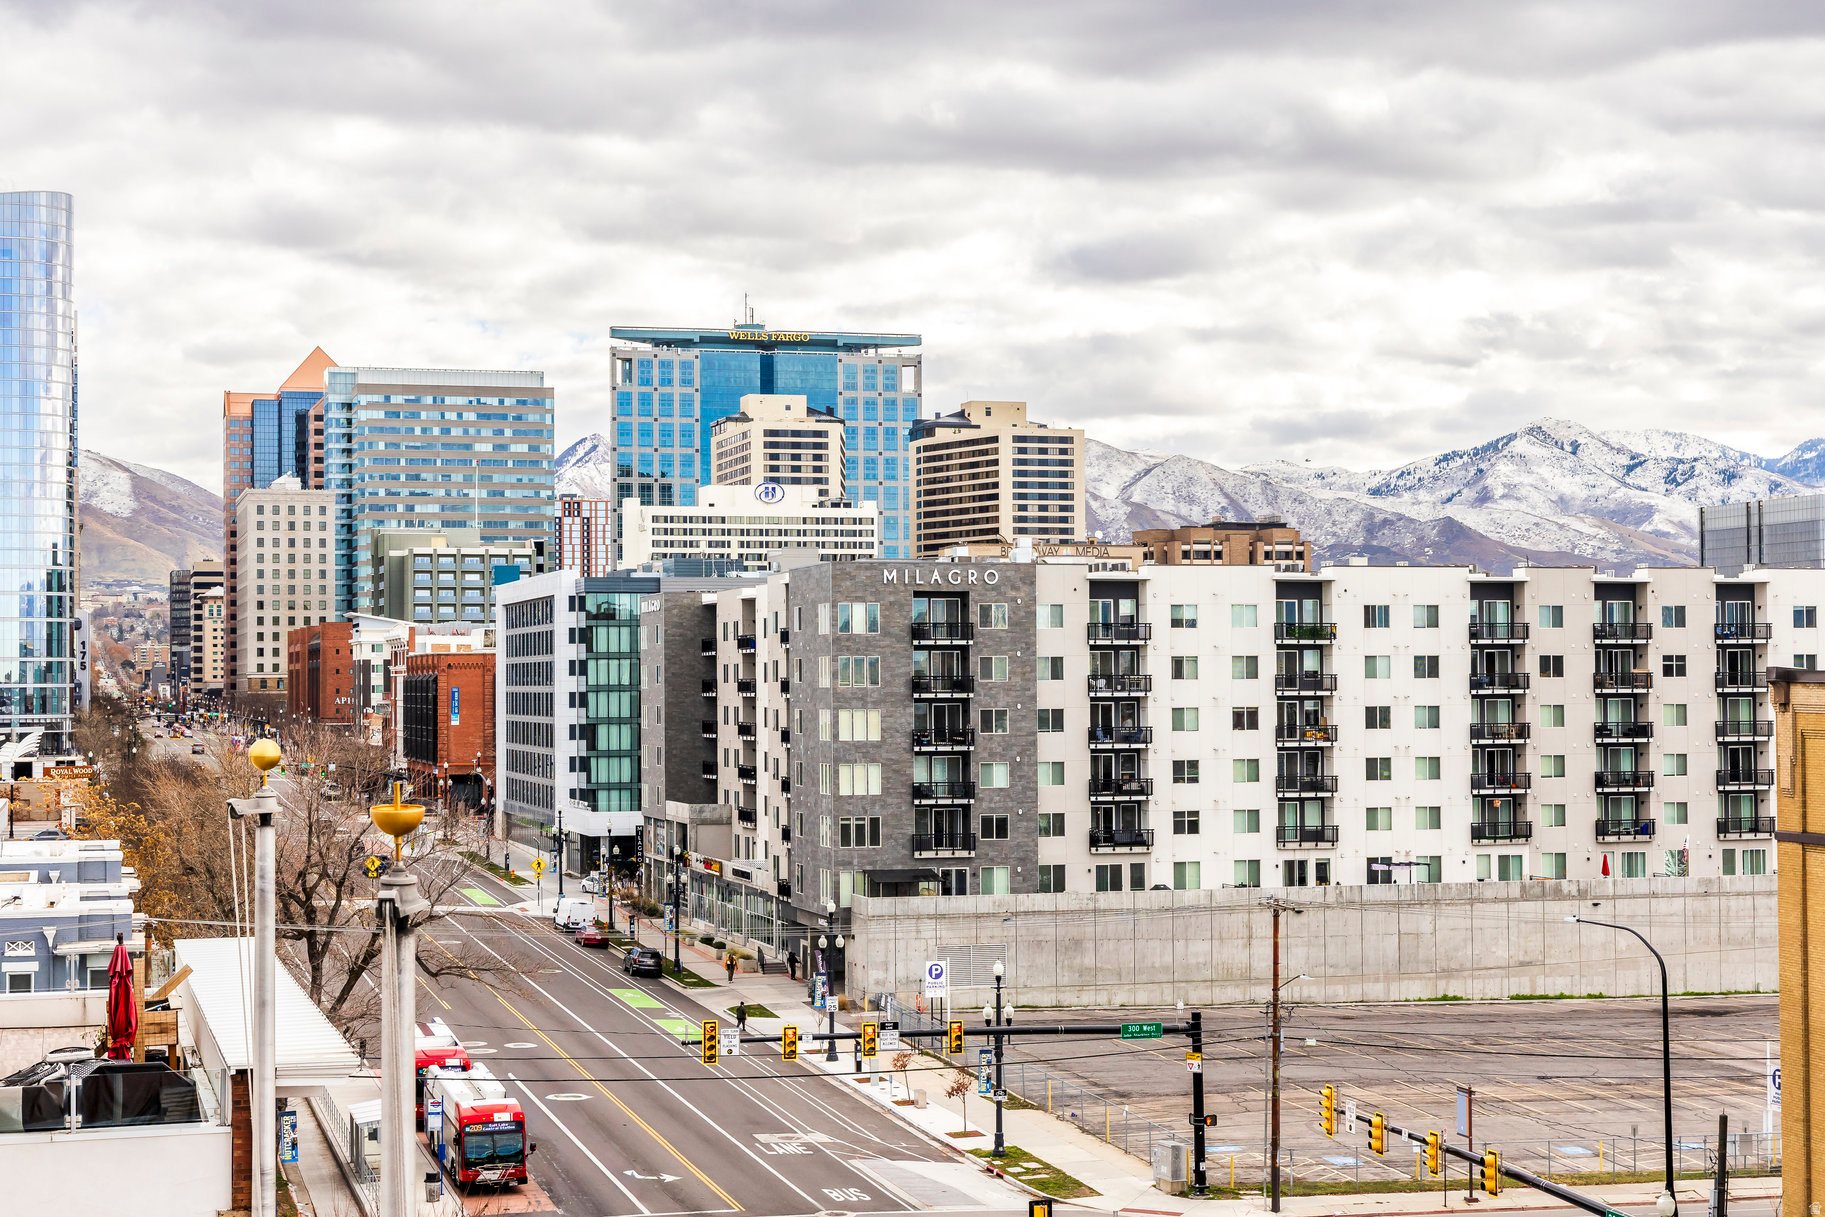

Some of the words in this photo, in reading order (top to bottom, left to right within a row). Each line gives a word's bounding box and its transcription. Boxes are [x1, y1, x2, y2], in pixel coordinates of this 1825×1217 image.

[728, 331, 769, 341] WELLS
[771, 332, 810, 342] FARGO
[1075, 546, 1110, 557] MEDIA
[883, 568, 999, 585] MILAGRO
[79, 640, 87, 671] 175
[50, 768, 73, 776] ROYAL
[469, 1124, 483, 1132] 209
[283, 1115, 293, 1161] NUTCRACKER
[754, 1142, 814, 1155] LANE
[820, 1187, 872, 1202] BUS
